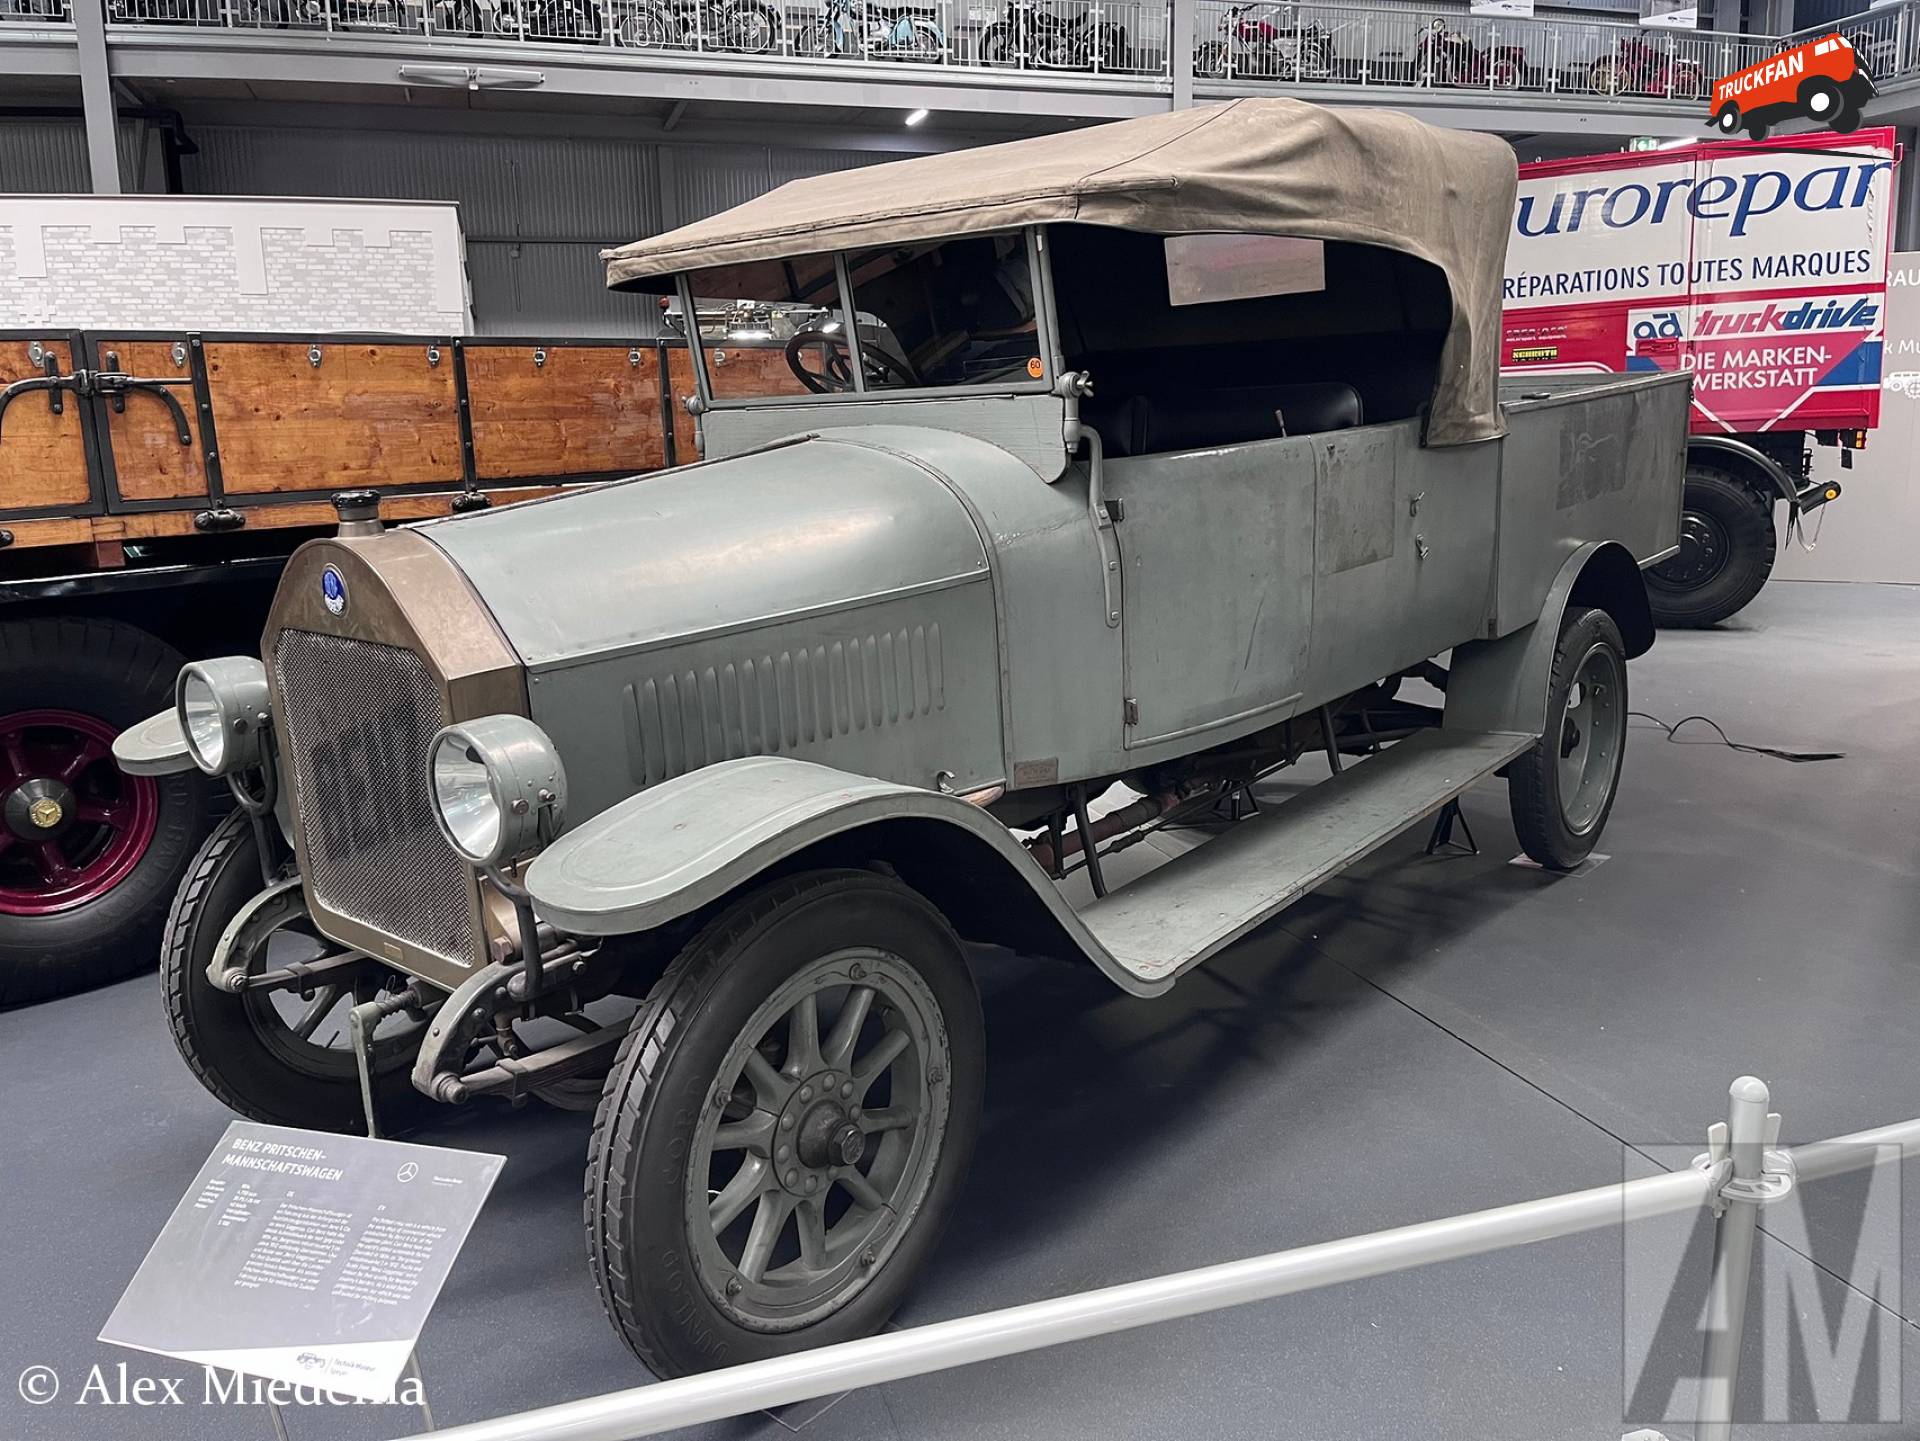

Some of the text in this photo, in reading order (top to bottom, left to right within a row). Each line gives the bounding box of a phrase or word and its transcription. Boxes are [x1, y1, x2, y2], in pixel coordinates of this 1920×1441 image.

[1502, 249, 1871, 300] RÉPARATIONS TOUTES MARQUES
[1030, 360, 1041, 369] 60
[1680, 345, 1832, 371] DIE MARKEN-
[1693, 367, 1818, 391] WERKSTATT
[232, 1138, 328, 1162] BENZ PRITSCHEN-
[221, 1153, 344, 1181] MANNSCHAFTSWAGEN
